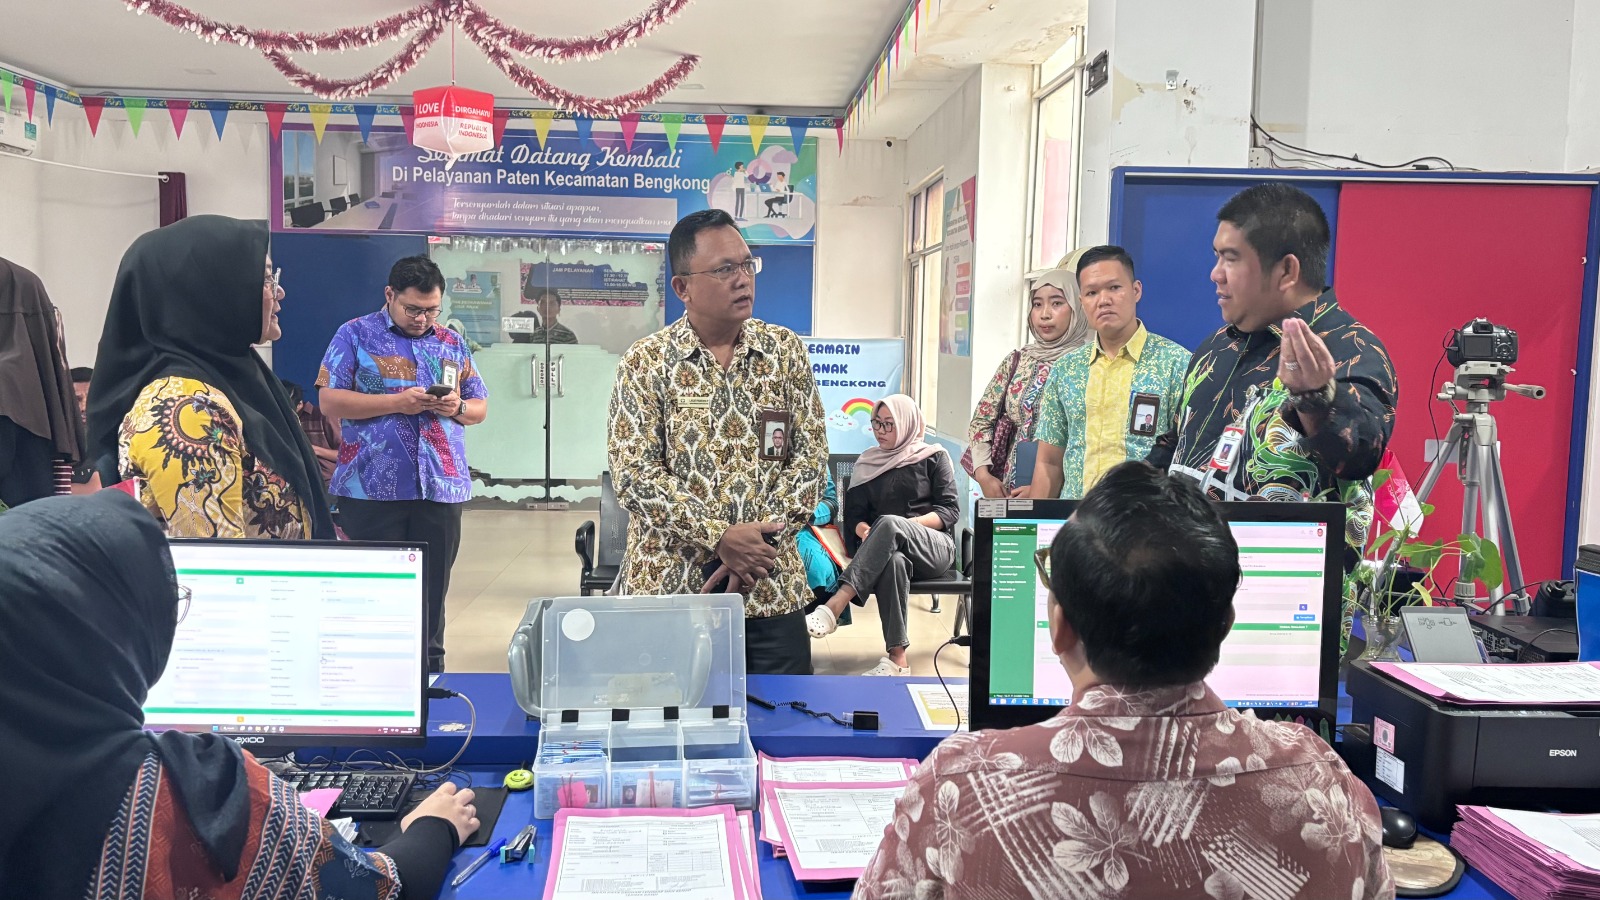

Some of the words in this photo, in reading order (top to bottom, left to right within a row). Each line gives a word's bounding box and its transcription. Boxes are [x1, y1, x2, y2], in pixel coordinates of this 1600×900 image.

[419, 102, 439, 114] LOVE
[455, 106, 490, 117] DIRGAHAYU
[460, 123, 488, 133] REPUBLIK
[459, 130, 488, 139] INDONESIA
[511, 145, 590, 171] Datang
[596, 146, 682, 169] Kembali
[392, 166, 408, 182] Di
[413, 166, 492, 187] Pelayanan
[497, 169, 540, 186] Paten
[545, 171, 629, 189] Kecamatan
[634, 174, 711, 194] Bengkong
[452, 197, 510, 213] Tersenyumlah
[512, 201, 539, 210] dalam
[541, 201, 565, 211] situasi
[478, 212, 513, 221] disadari
[514, 215, 545, 226] senyum
[547, 213, 558, 223] itu
[559, 216, 581, 227] yang
[583, 216, 603, 224] akan
[605, 217, 655, 229] menguatkan
[806, 343, 860, 354] ERMAIN
[812, 363, 848, 374] ANAK
[1549, 749, 1577, 757] EPSON
